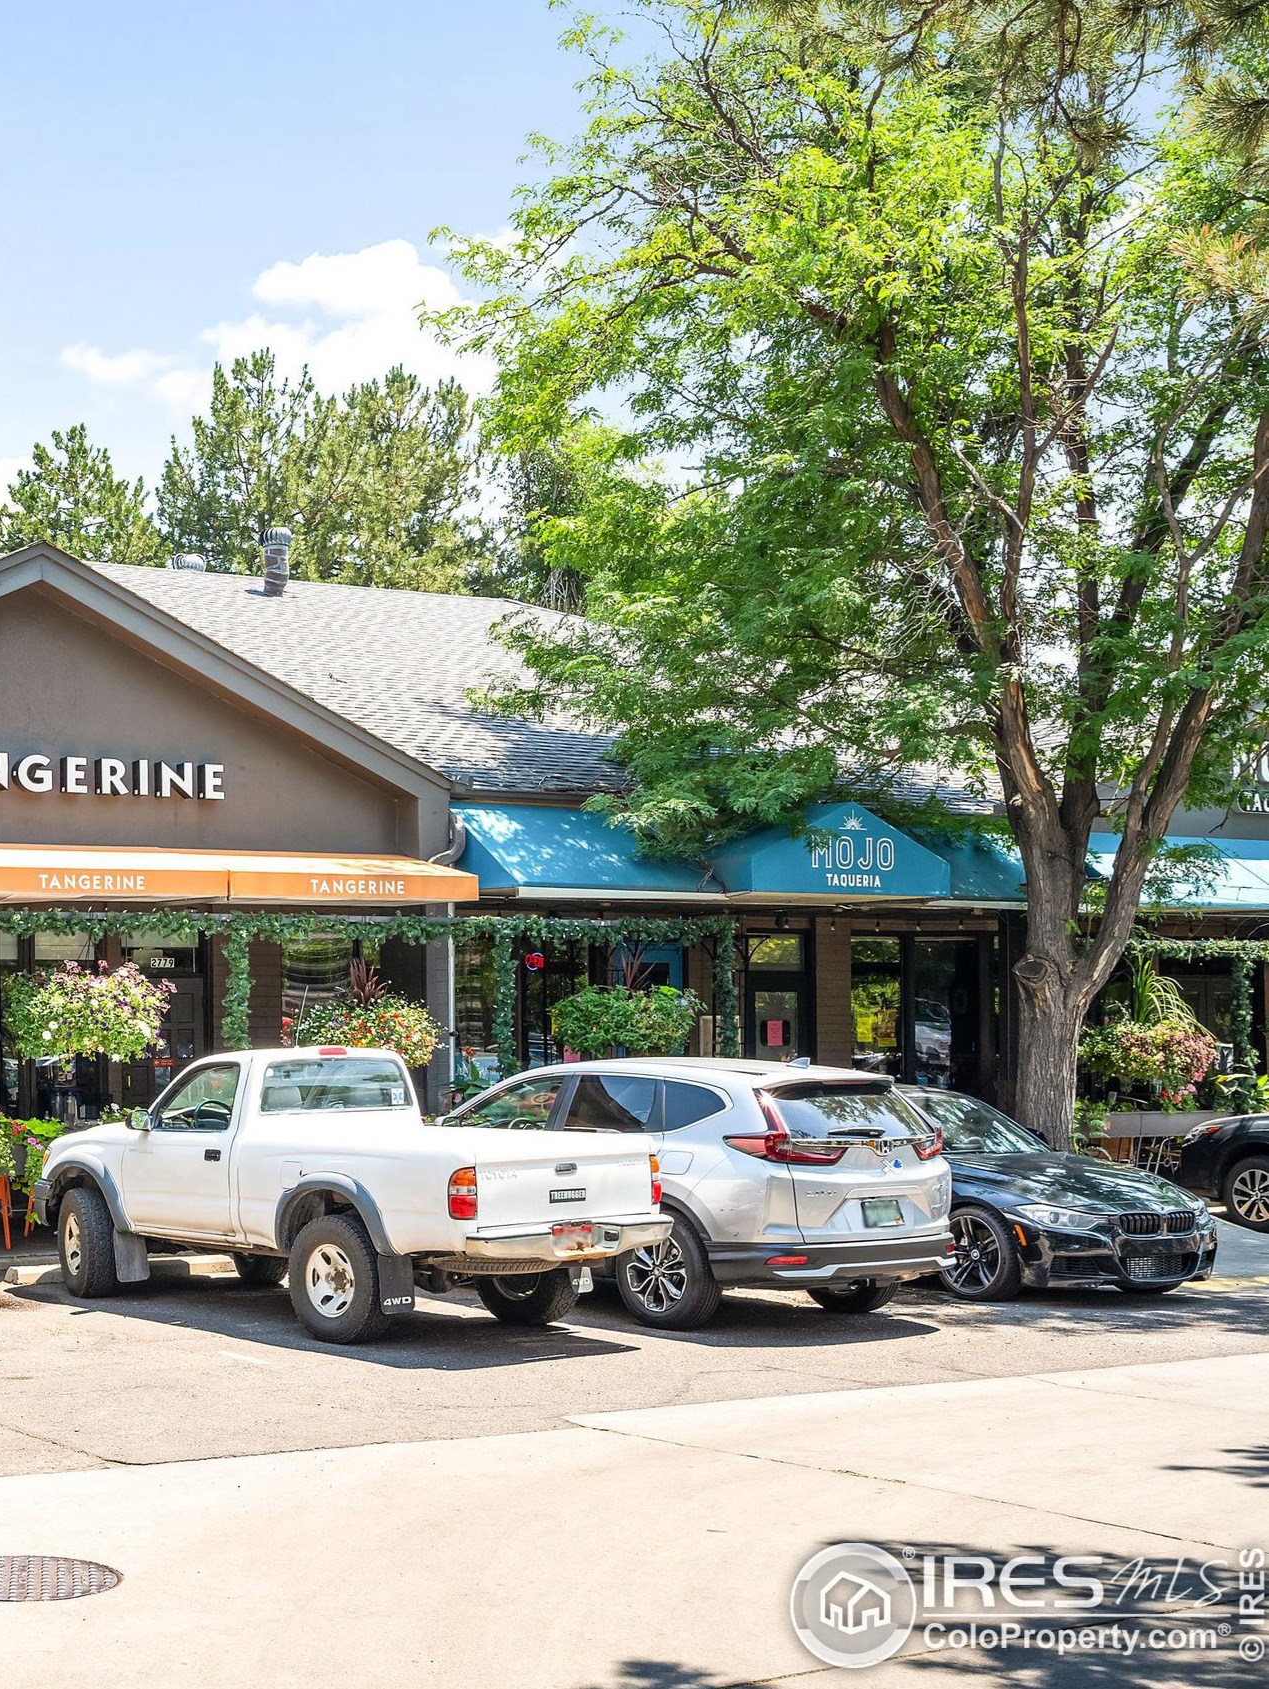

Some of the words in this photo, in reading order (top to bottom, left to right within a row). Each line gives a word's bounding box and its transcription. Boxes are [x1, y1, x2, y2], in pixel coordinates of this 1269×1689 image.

[811, 834, 895, 872] MOJO
[38, 873, 146, 891] TANGERINE
[310, 878, 405, 895] TANGERINE
[825, 873, 882, 888] TAQUERIA
[151, 958, 174, 968] 2779
[480, 1167, 519, 1182] TOYOTA
[572, 1277, 590, 1286] 4WD
[383, 1296, 411, 1306] 4WD
